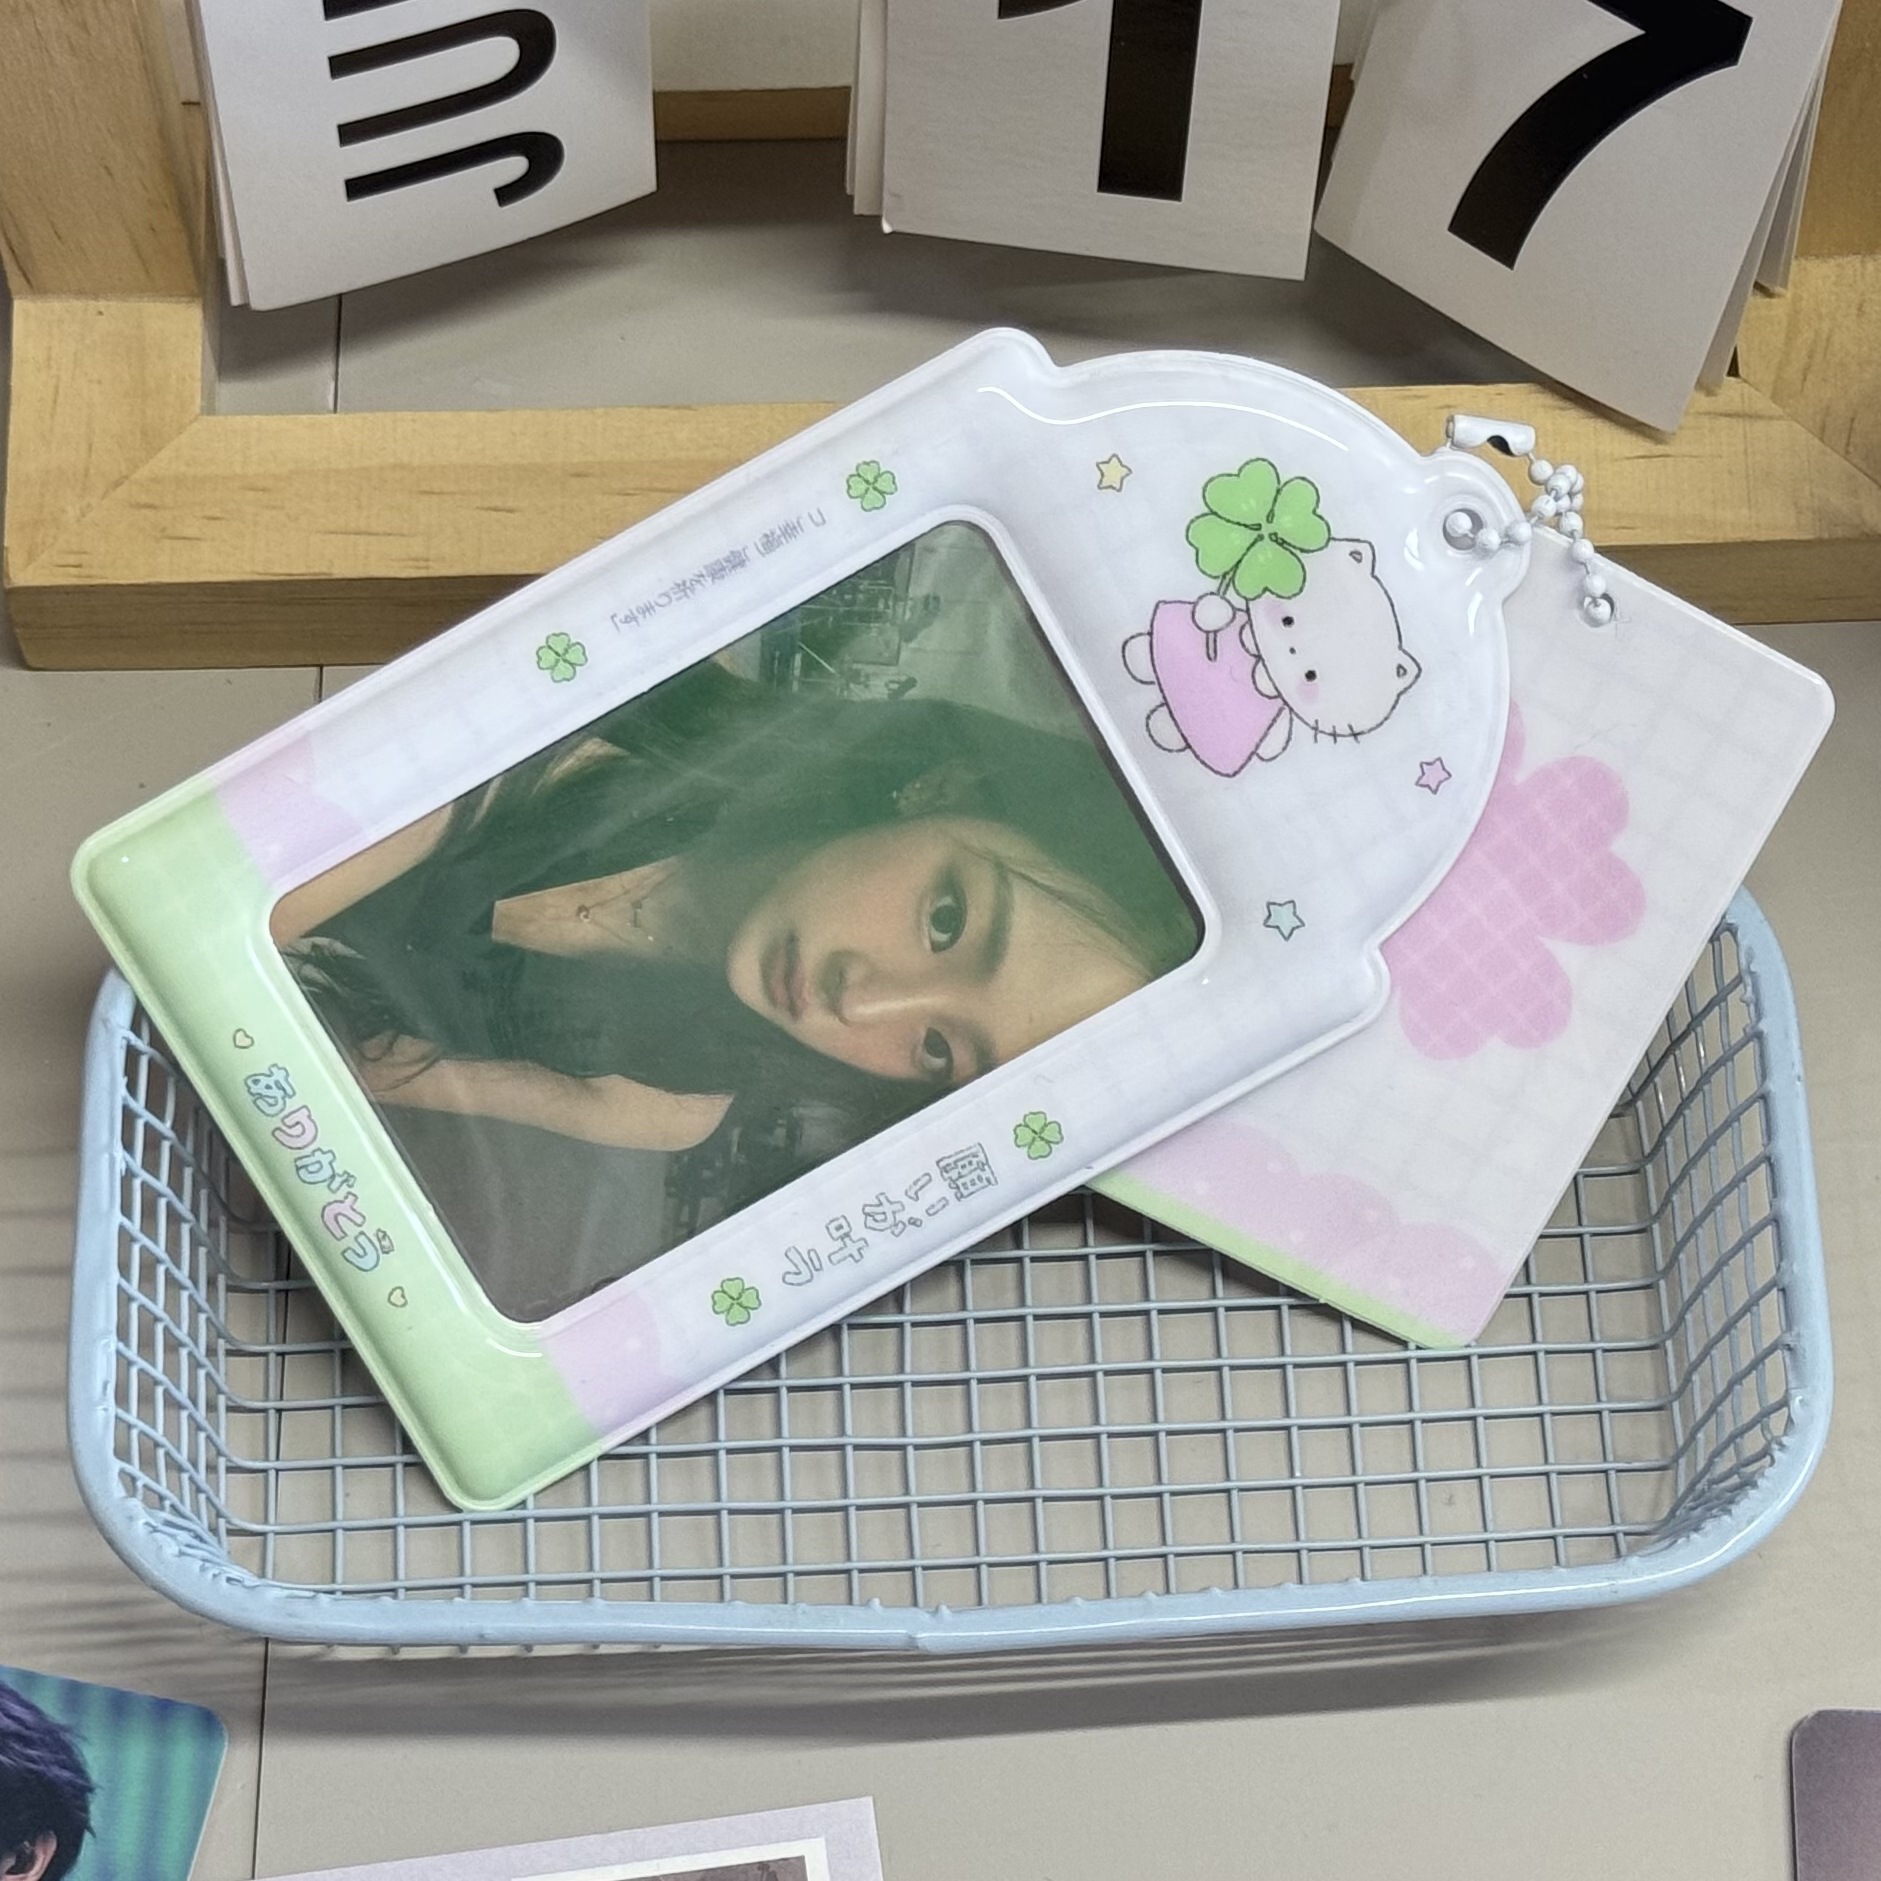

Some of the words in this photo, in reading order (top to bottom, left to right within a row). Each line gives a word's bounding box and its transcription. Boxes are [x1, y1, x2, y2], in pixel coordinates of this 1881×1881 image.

[323, 0, 565, 208] JU
[244, 1063, 394, 1272] ありがとう
[782, 1142, 998, 1286] 願いが叶う
